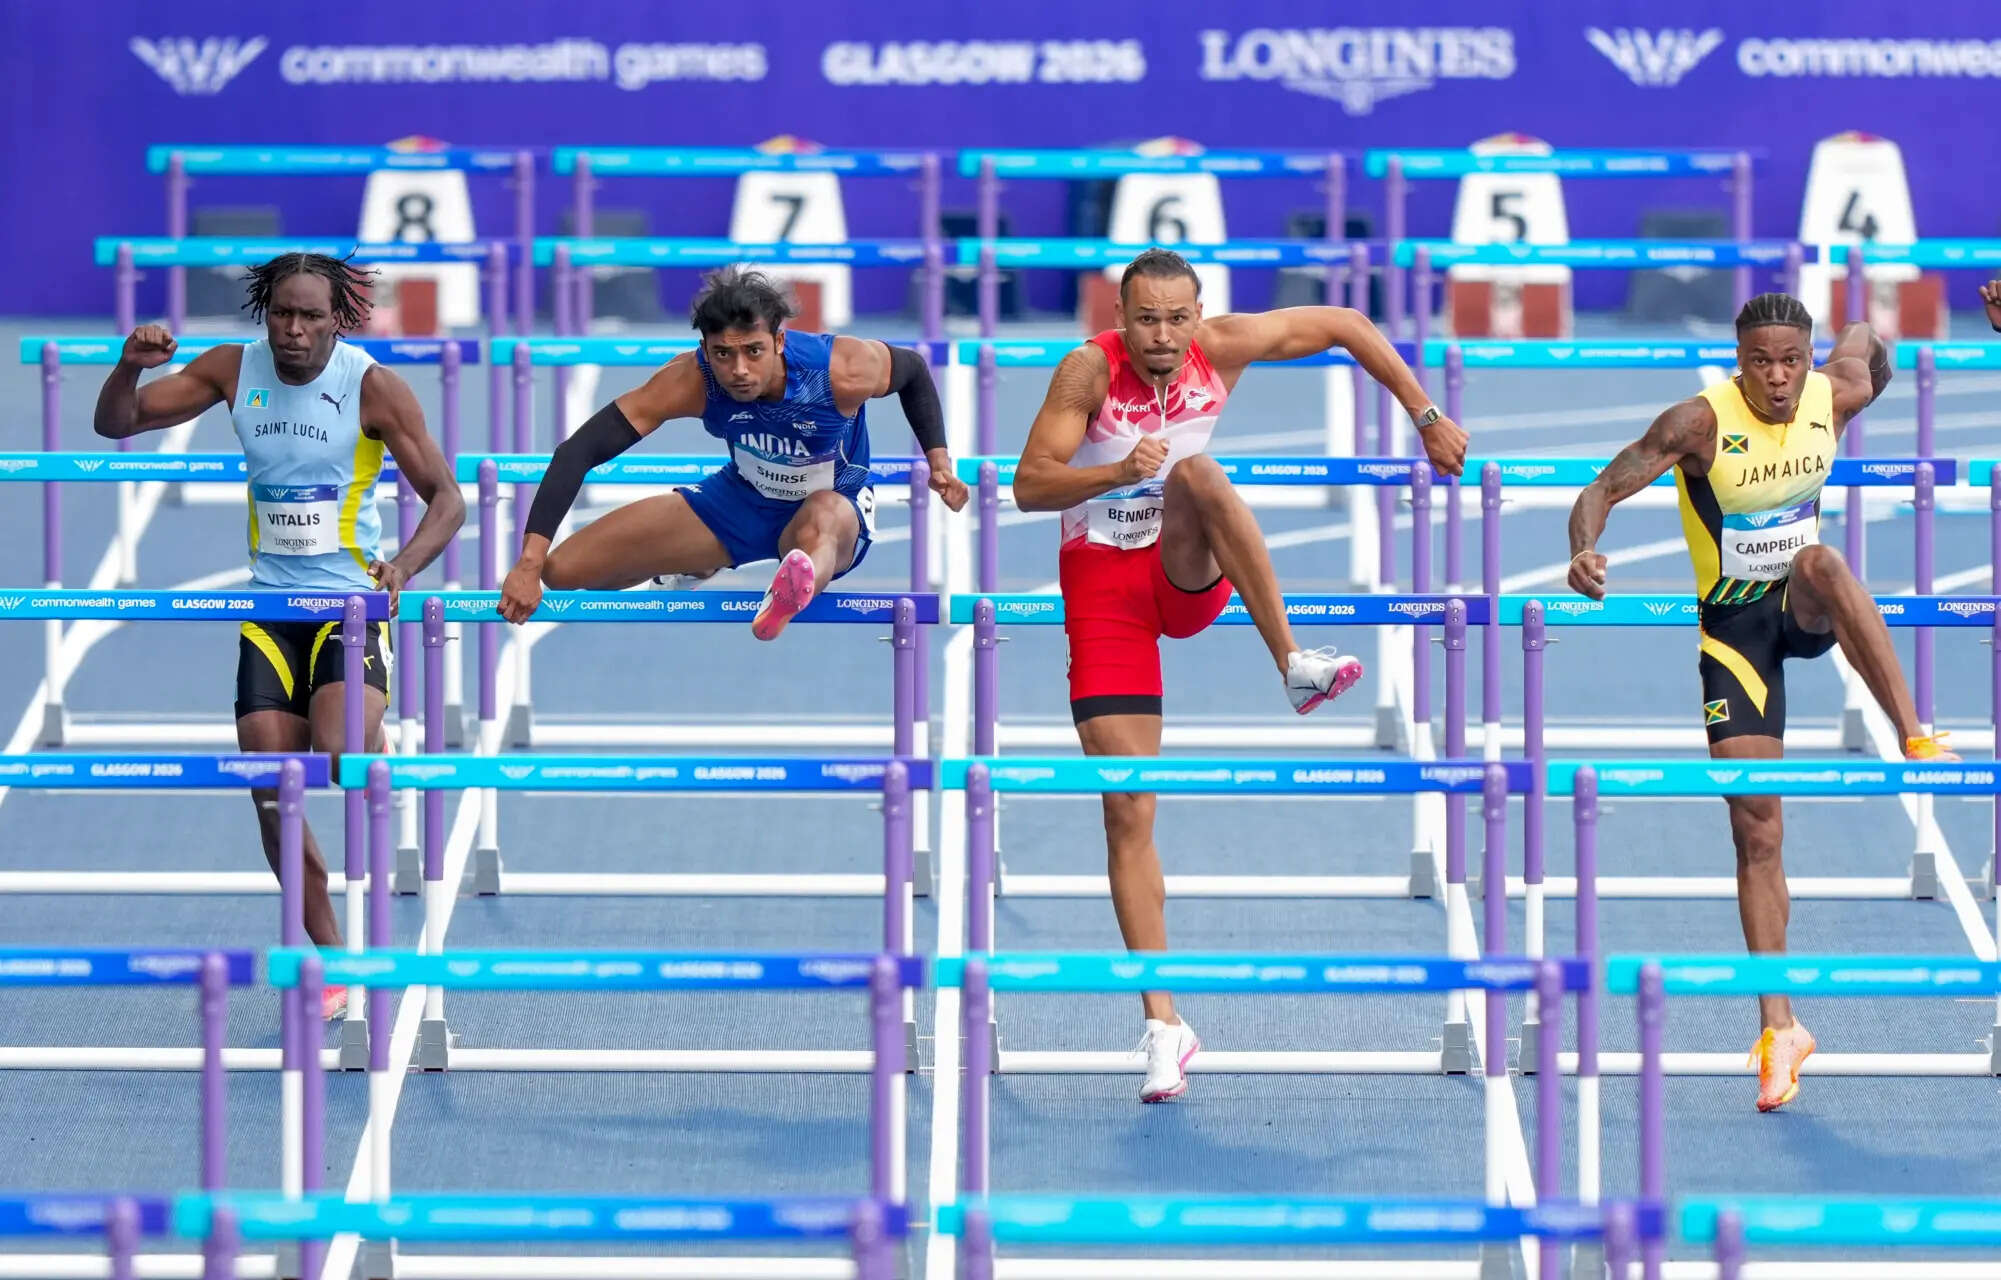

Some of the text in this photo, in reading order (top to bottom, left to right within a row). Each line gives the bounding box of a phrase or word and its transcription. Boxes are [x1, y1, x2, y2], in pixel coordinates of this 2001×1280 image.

[282, 27, 1516, 89] commonwealth games GLASGOW 2026 LONGINES
[395, 193, 436, 242] 8
[769, 194, 804, 242] 7
[1148, 195, 1188, 244] 6
[1492, 192, 1528, 243] 5
[1838, 190, 1879, 242] 4
[255, 421, 328, 443] SAINT LUCIA
[740, 433, 811, 457] INDIA
[109, 461, 187, 470] commonwealth
[188, 462, 225, 472] games
[623, 464, 701, 474] commonwealth
[1251, 464, 1411, 476] GLASGOW 2026 LONGINES
[1502, 464, 1555, 473] LONGINES
[1736, 455, 1825, 487] JAMAICA
[1861, 464, 1915, 473] LONGINES
[757, 466, 808, 484] SHIRSE
[755, 481, 807, 497] LONGINES
[267, 513, 321, 526] VITALIS
[275, 538, 318, 547] LONGINES
[1736, 535, 1806, 555] CAMPBELL
[31, 597, 345, 610] commonwealth games GLASGOW 2026 LONGINES
[580, 600, 665, 610] commonwealth
[666, 601, 705, 613] games
[836, 599, 894, 609] LONGINES
[997, 602, 1055, 612] LONGINES
[1286, 605, 1326, 614] ASGOW
[1328, 605, 1356, 615] 2026
[1387, 602, 1446, 612] LONGINES
[1546, 601, 1996, 615] LONGINES 2026 LONGINES
[90, 763, 152, 777] GLASGOW
[150, 763, 183, 777] 2026
[694, 767, 755, 780] GLASGOW
[753, 767, 787, 780] 2026
[1293, 769, 1354, 783] GLASGOW
[1352, 769, 1386, 783] 2026
[1902, 771, 1963, 784] GLASGOW
[1961, 771, 1995, 785] 2026
